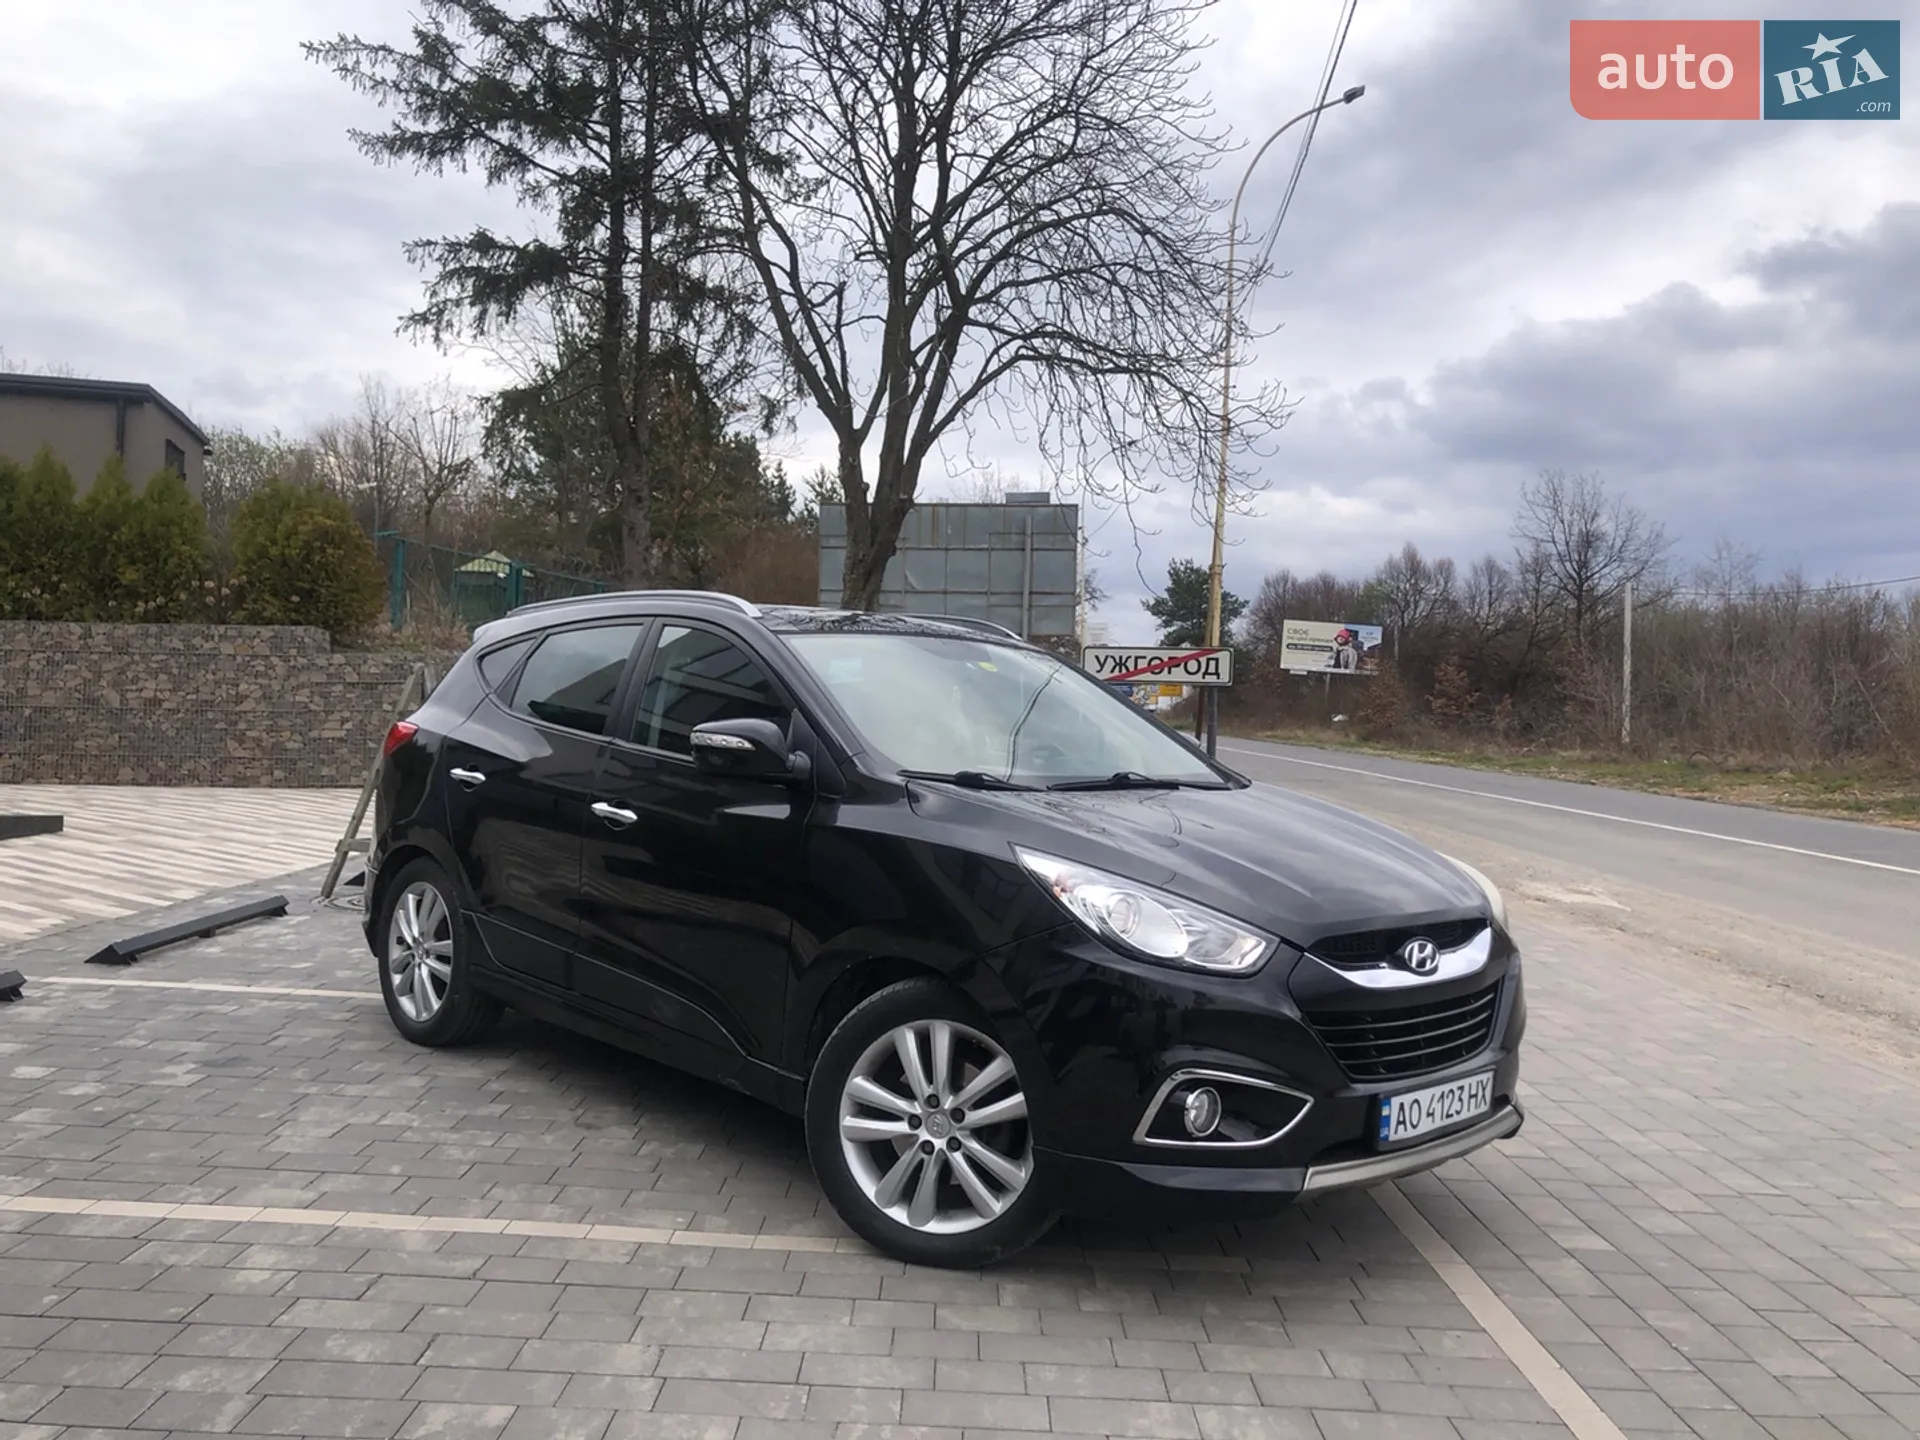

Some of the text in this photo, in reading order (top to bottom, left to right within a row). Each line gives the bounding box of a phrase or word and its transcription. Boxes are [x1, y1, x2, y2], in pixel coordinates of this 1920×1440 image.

[1094, 654, 1221, 680] УЖГОРОД
[1394, 1078, 1490, 1135] AO 4123 HX
